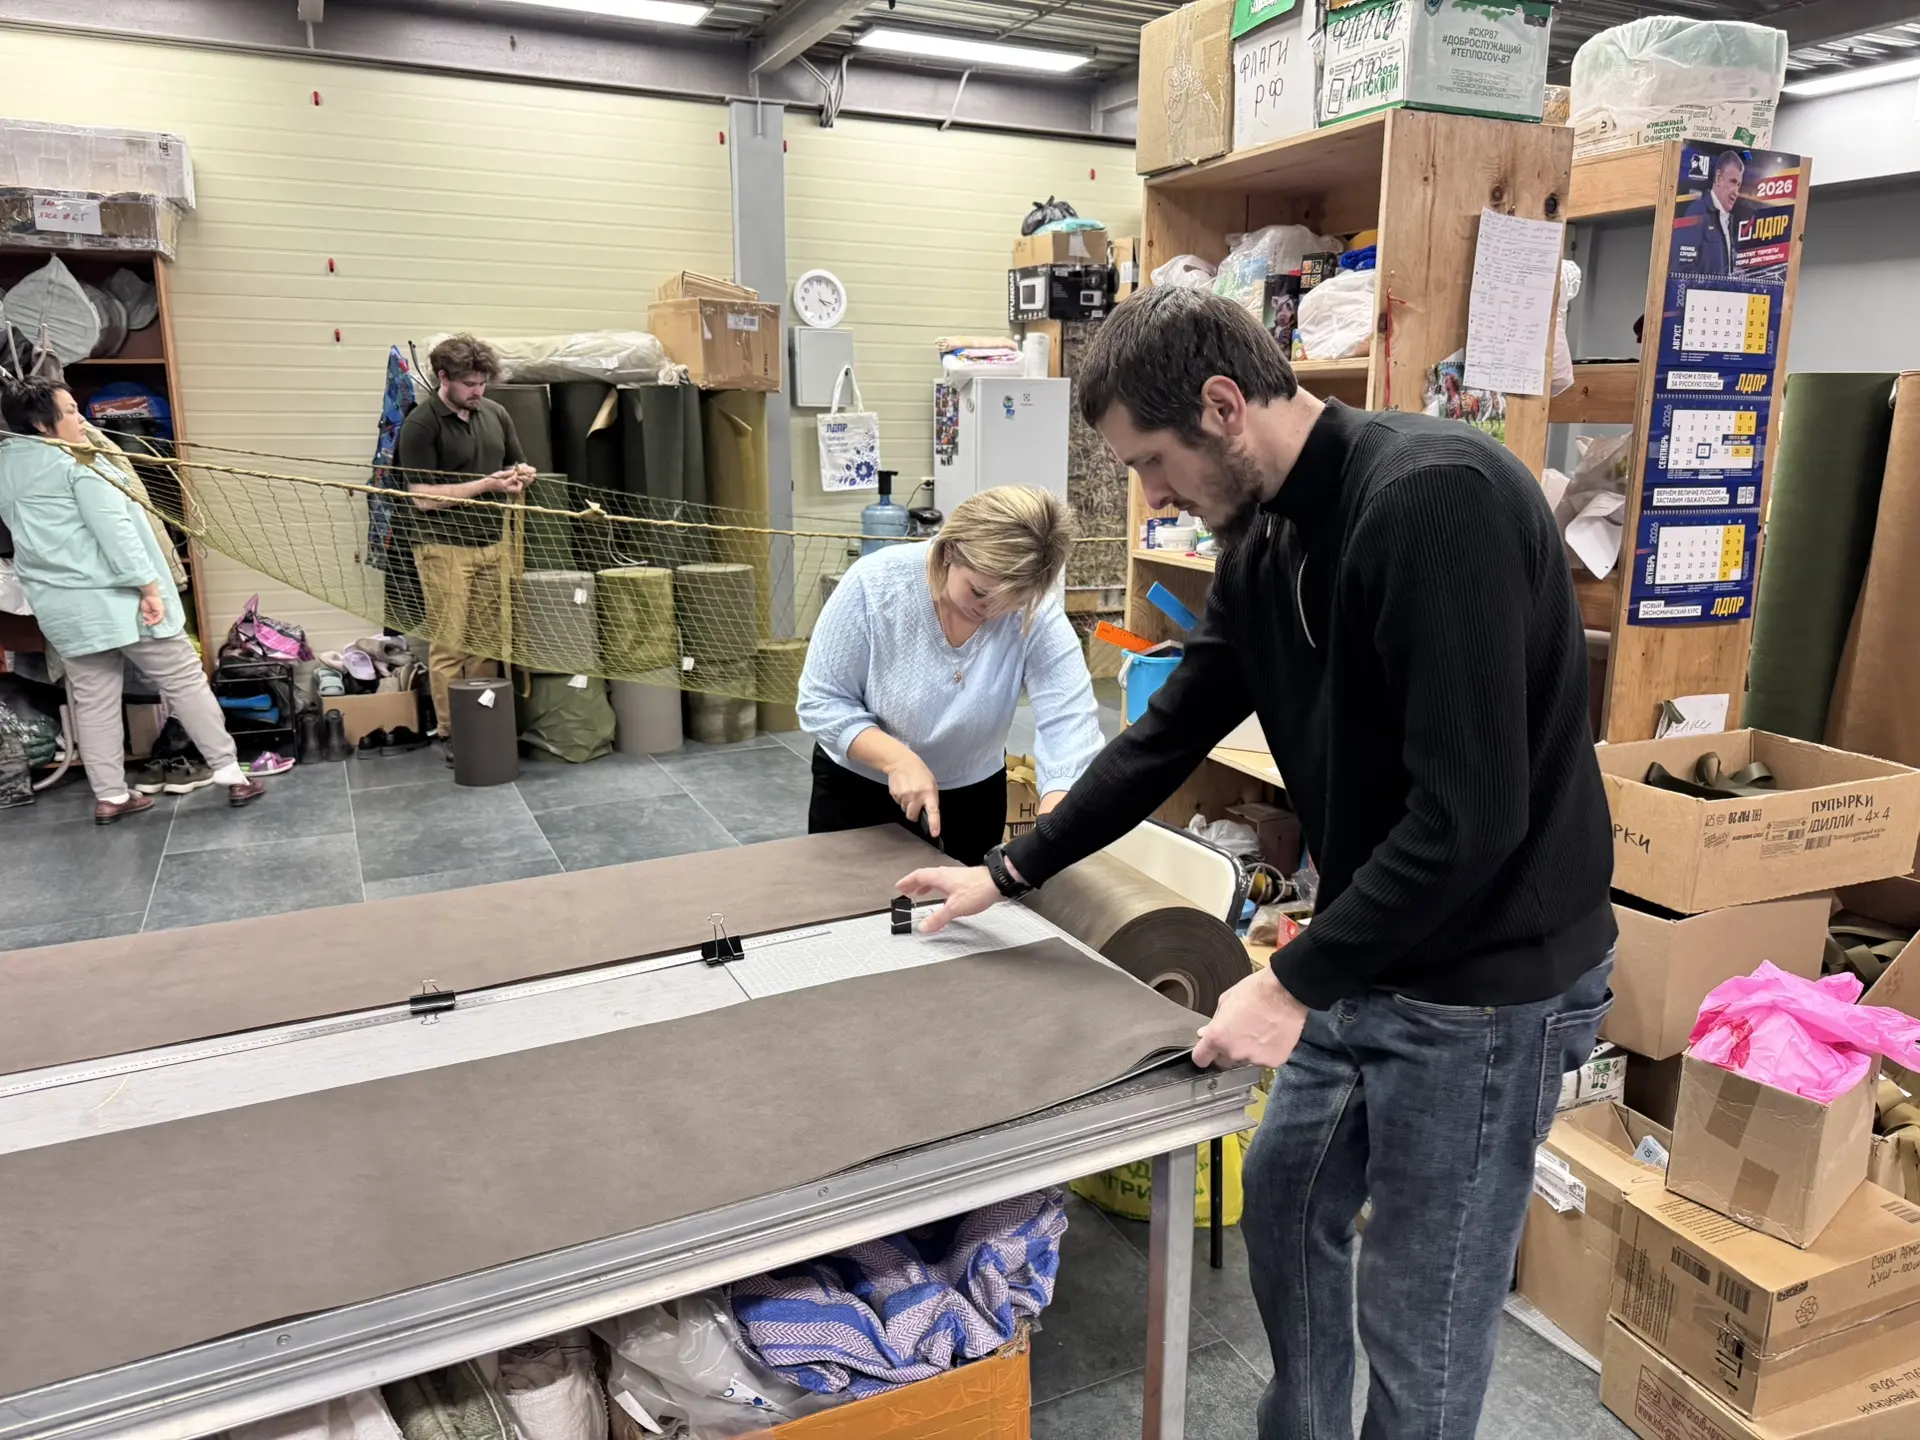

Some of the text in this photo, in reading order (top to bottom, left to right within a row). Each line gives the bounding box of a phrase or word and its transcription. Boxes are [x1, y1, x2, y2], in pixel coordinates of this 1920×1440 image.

[1333, 1, 1402, 55] ФЛАГИ
[1468, 27, 1498, 39] #СКР87
[1442, 35, 1522, 55] #ДОБРОСЛУЖАЩИЙ
[1240, 37, 1290, 83] ФЛАГИ
[1451, 48, 1510, 64] #ТЕПЛОZOV-87
[1757, 179, 1793, 197] 2026
[1753, 215, 1789, 241] ЛДПР
[1676, 283, 1686, 307] 2026
[1672, 324, 1683, 350] АВГУСТ
[1735, 373, 1767, 394] ЛДПР
[1662, 404, 1672, 427] 2026
[826, 423, 848, 433] ЛДПР
[1658, 435, 1670, 469] СЕНТЯБРЬ
[1650, 522, 1659, 544] 2026
[1711, 597, 1744, 617] ЛДПР
[1812, 794, 1873, 814] ПУПЫРКИ
